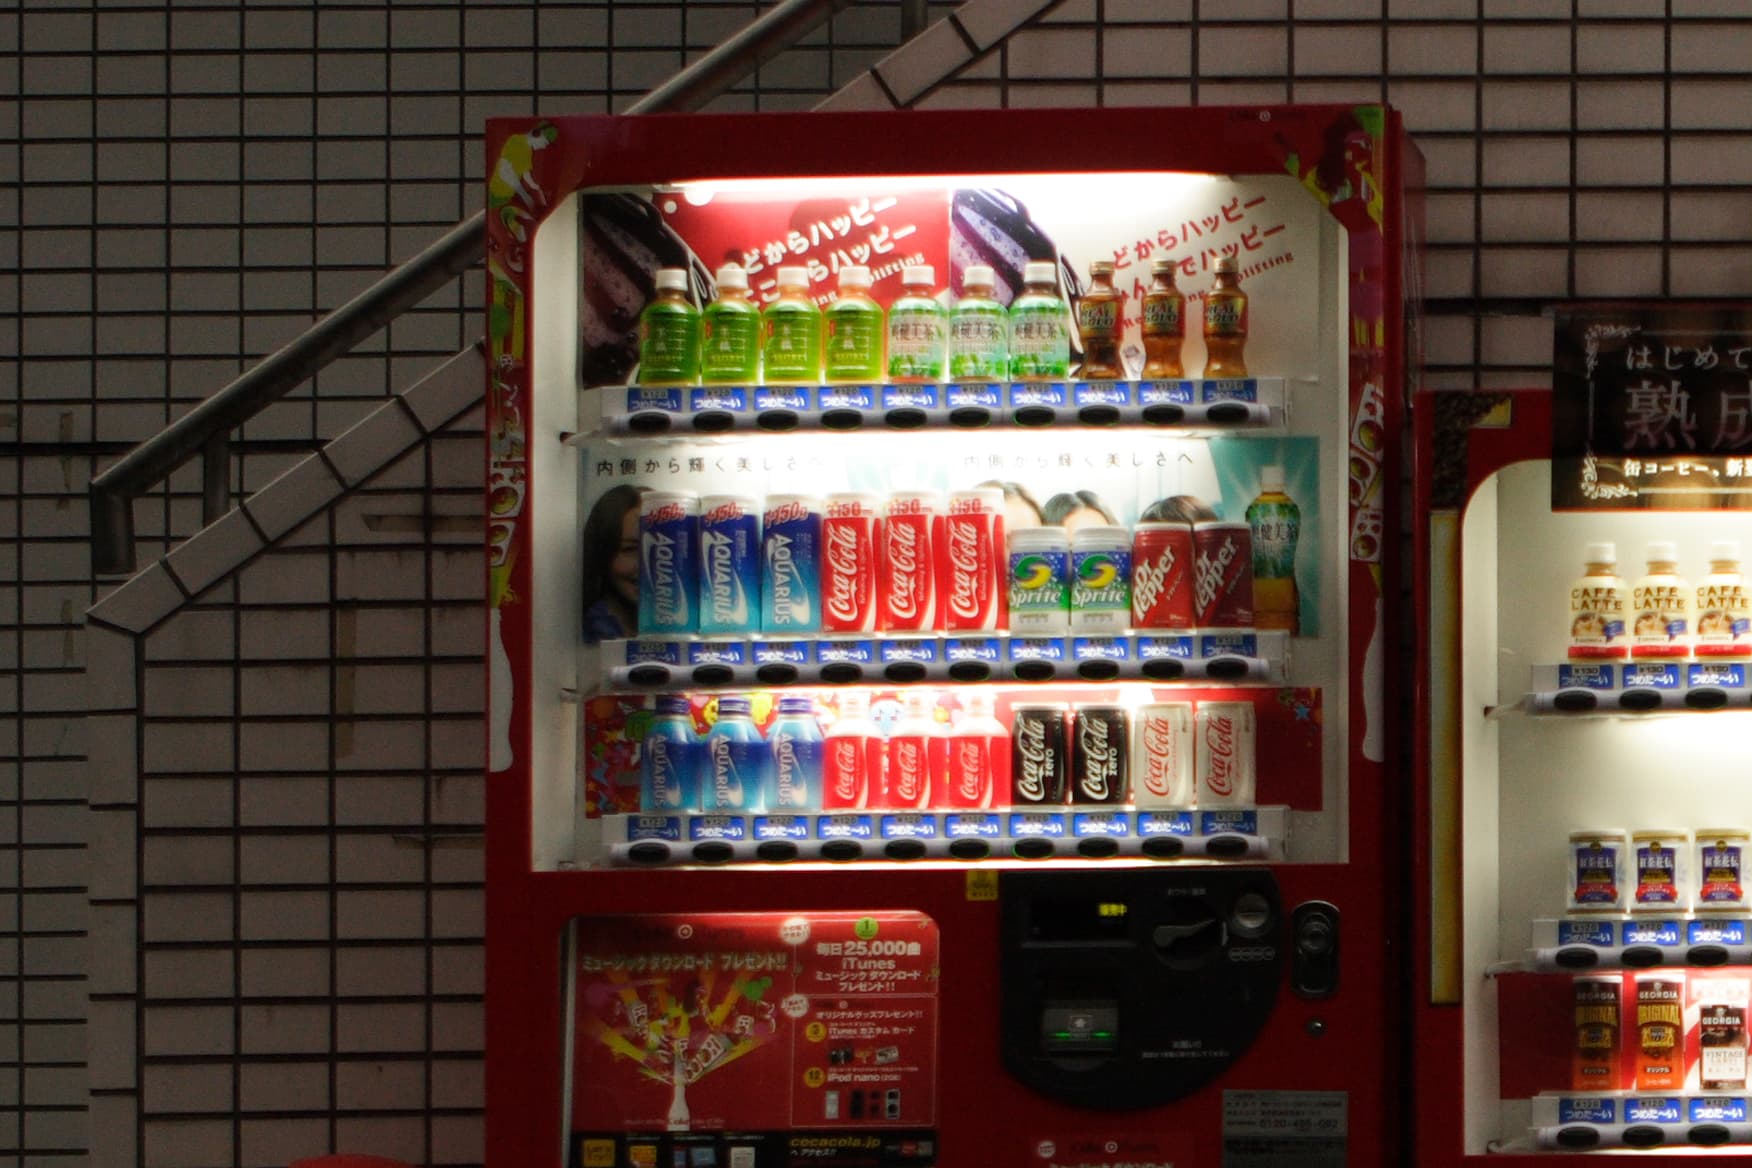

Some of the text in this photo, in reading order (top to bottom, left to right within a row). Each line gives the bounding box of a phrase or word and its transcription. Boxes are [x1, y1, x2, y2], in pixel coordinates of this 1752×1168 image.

[653, 532, 675, 627] AQUARIUS
[712, 531, 733, 625] AQUARIUS
[772, 534, 793, 624] AQUARIUS
[1133, 543, 1177, 623] Pepper
[1009, 587, 1063, 606] Sprite
[1071, 587, 1126, 606] Sprite
[1571, 598, 1622, 610] LATTE
[1633, 597, 1685, 610] LATTE
[1697, 597, 1749, 609] LATTE
[653, 733, 669, 808] AQUARIUS
[715, 732, 731, 808] AQUARIUS
[778, 732, 794, 807] AQUARIUS
[842, 957, 896, 969] iTunes
[1638, 991, 1678, 1000] GEORGIA
[1702, 1017, 1741, 1025] GEORGIA
